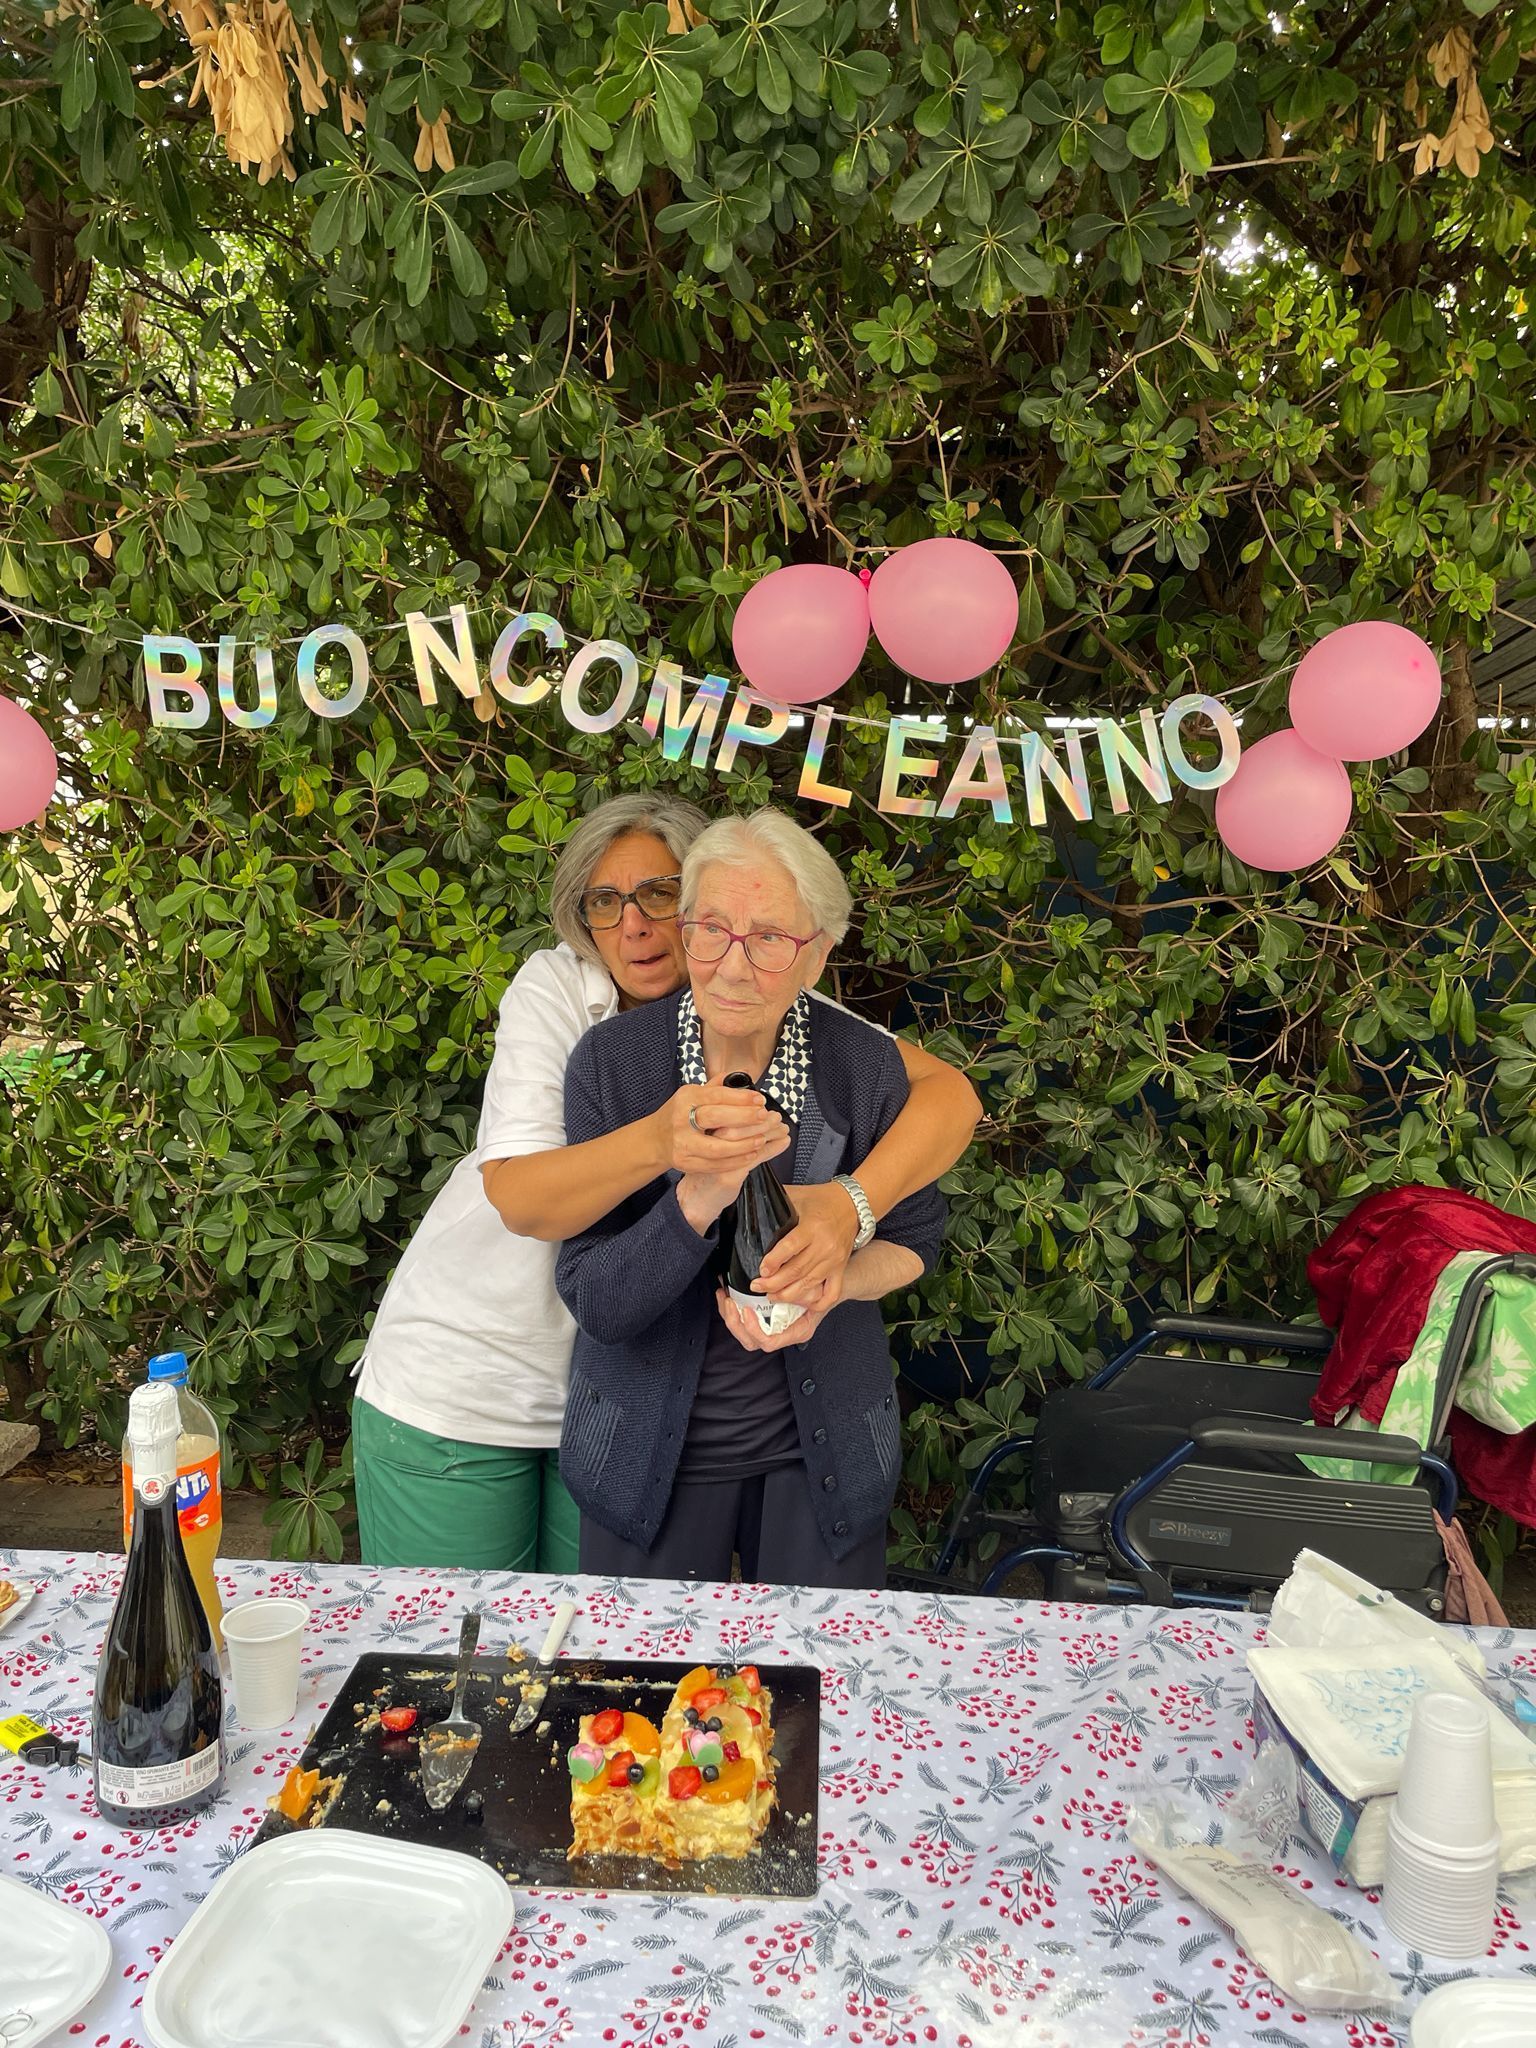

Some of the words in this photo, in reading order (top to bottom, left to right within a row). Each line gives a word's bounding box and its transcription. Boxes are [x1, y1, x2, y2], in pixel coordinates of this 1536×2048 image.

[143, 604, 482, 729] BUON
[490, 612, 1242, 827] COMPLEANNO
[176, 1469, 211, 1499] NTA
[1177, 1522, 1226, 1543] Breezy
